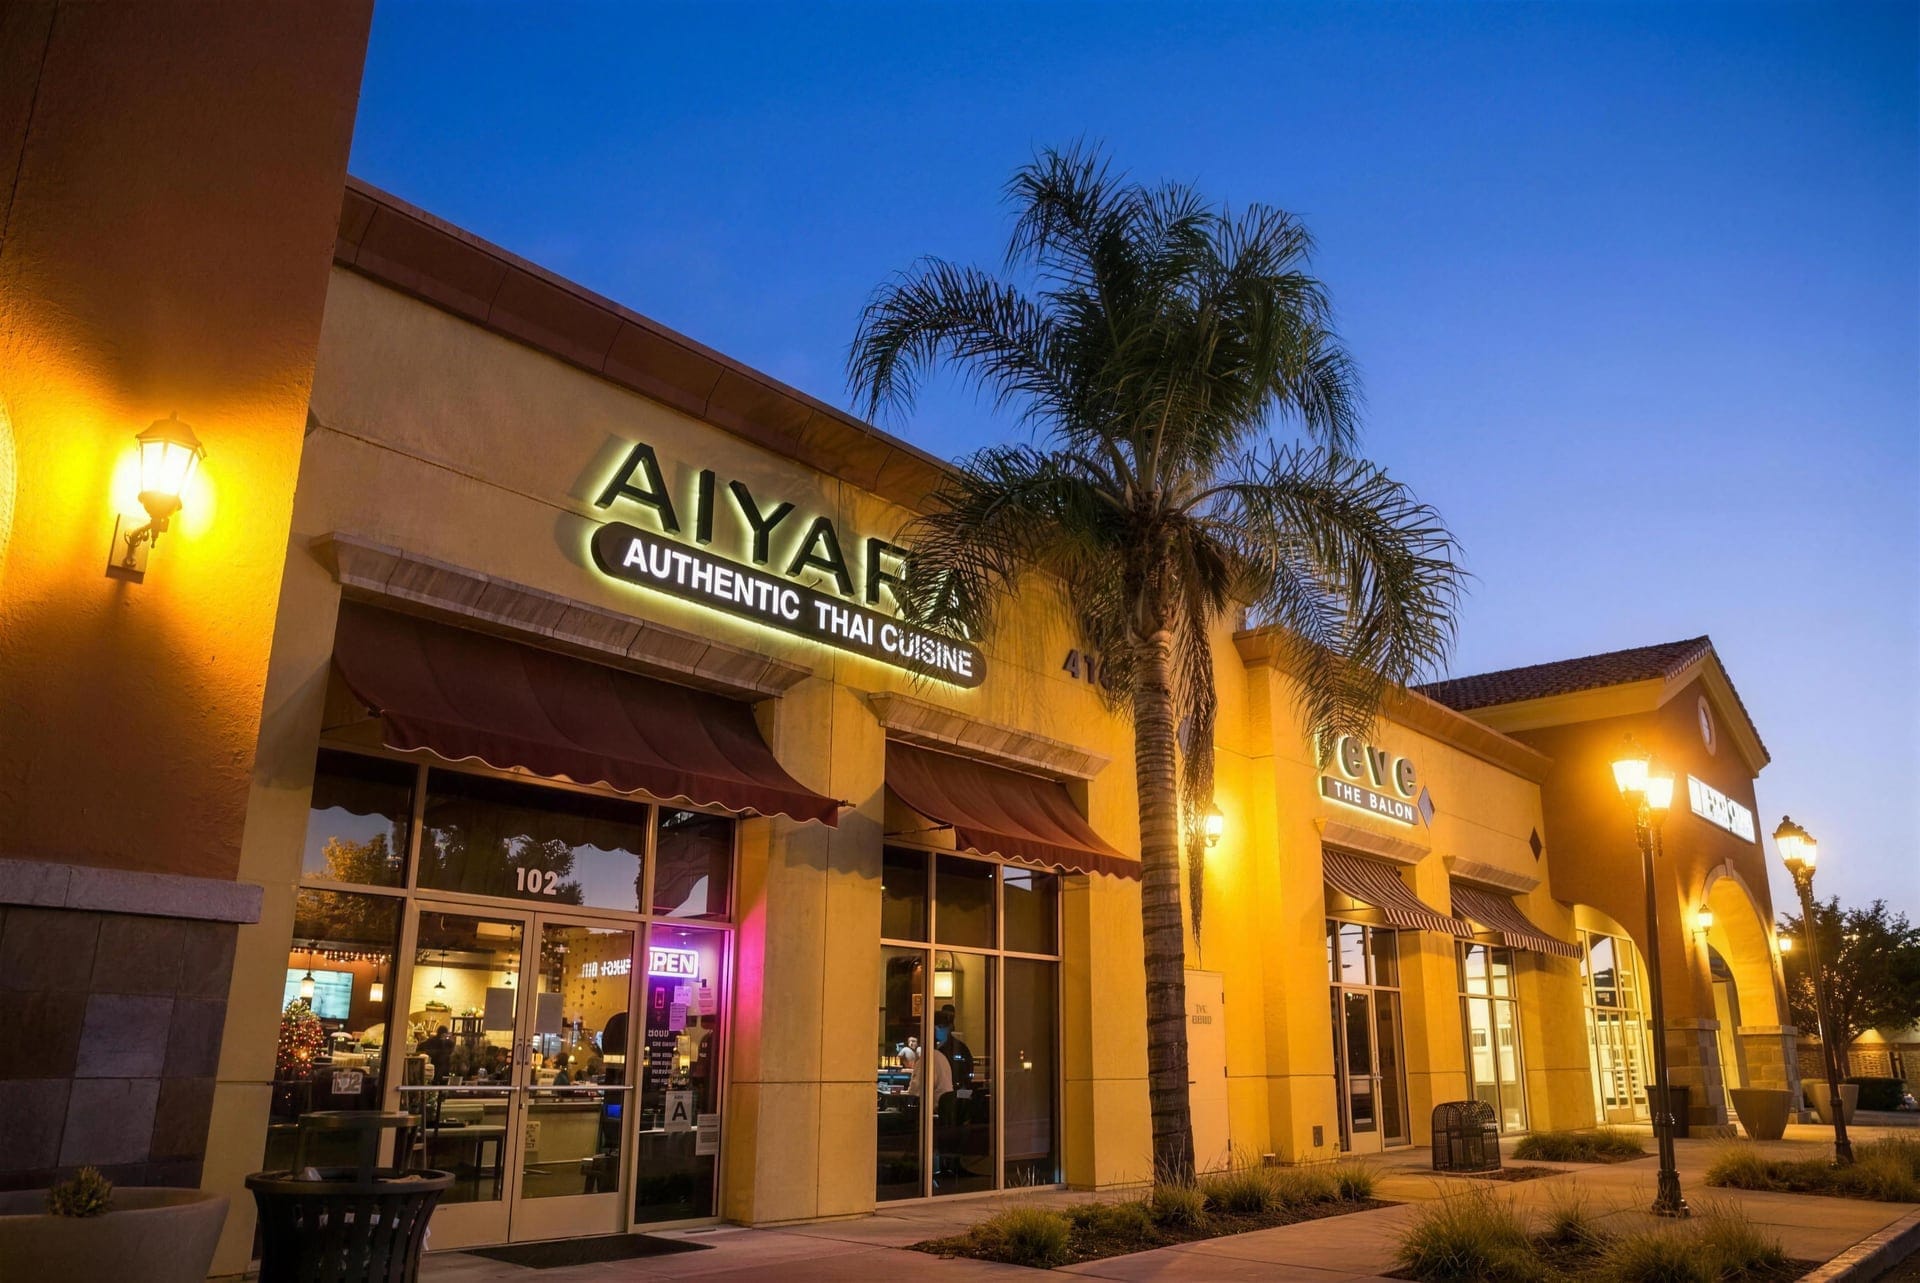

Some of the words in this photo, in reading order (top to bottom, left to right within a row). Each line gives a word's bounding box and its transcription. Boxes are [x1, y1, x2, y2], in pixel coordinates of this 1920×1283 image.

[623, 538, 800, 620] AUTHENTIC
[814, 600, 873, 645] THAI
[880, 623, 973, 677] CUISINE
[1063, 649, 1114, 691] 41
[1316, 727, 1418, 797] eve
[1334, 781, 1361, 804] THE
[1369, 793, 1413, 820] BALON
[516, 867, 558, 896] 102
[649, 951, 694, 974] PEN
[672, 1101, 688, 1121] A
